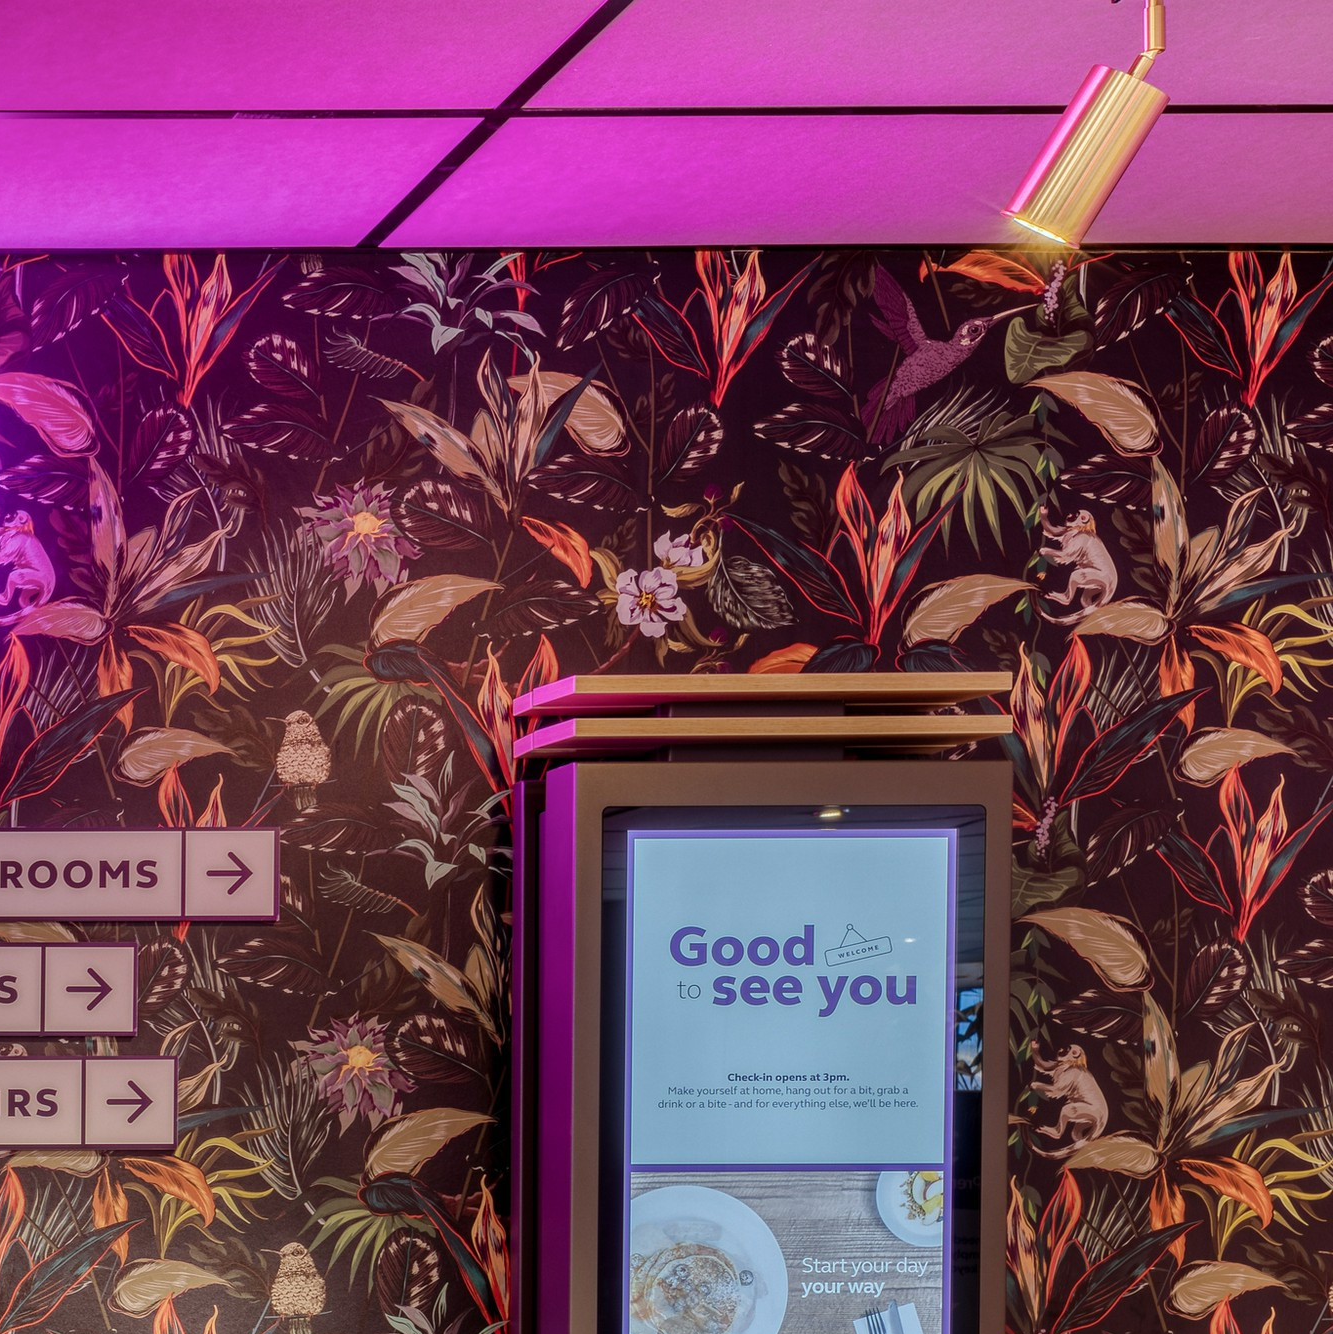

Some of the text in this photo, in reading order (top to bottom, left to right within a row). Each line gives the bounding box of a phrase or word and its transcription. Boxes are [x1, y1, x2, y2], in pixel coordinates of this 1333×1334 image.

[670, 924, 814, 967] Good
[838, 944, 879, 958] WELCOME
[677, 975, 916, 1017] to see you
[728, 1072, 849, 1083] Check-in opens at 3pm.
[668, 1086, 694, 1095] Make
[697, 1085, 739, 1097] yourself
[740, 1085, 750, 1094] at
[753, 1085, 783, 1096] home,
[786, 1085, 811, 1097] hang
[812, 1085, 832, 1094] out
[834, 1085, 847, 1094] for
[859, 1085, 875, 1095] bit,
[877, 1085, 900, 1096] grab
[802, 1257, 928, 1277] Start your day
[801, 1282, 885, 1298] your way
